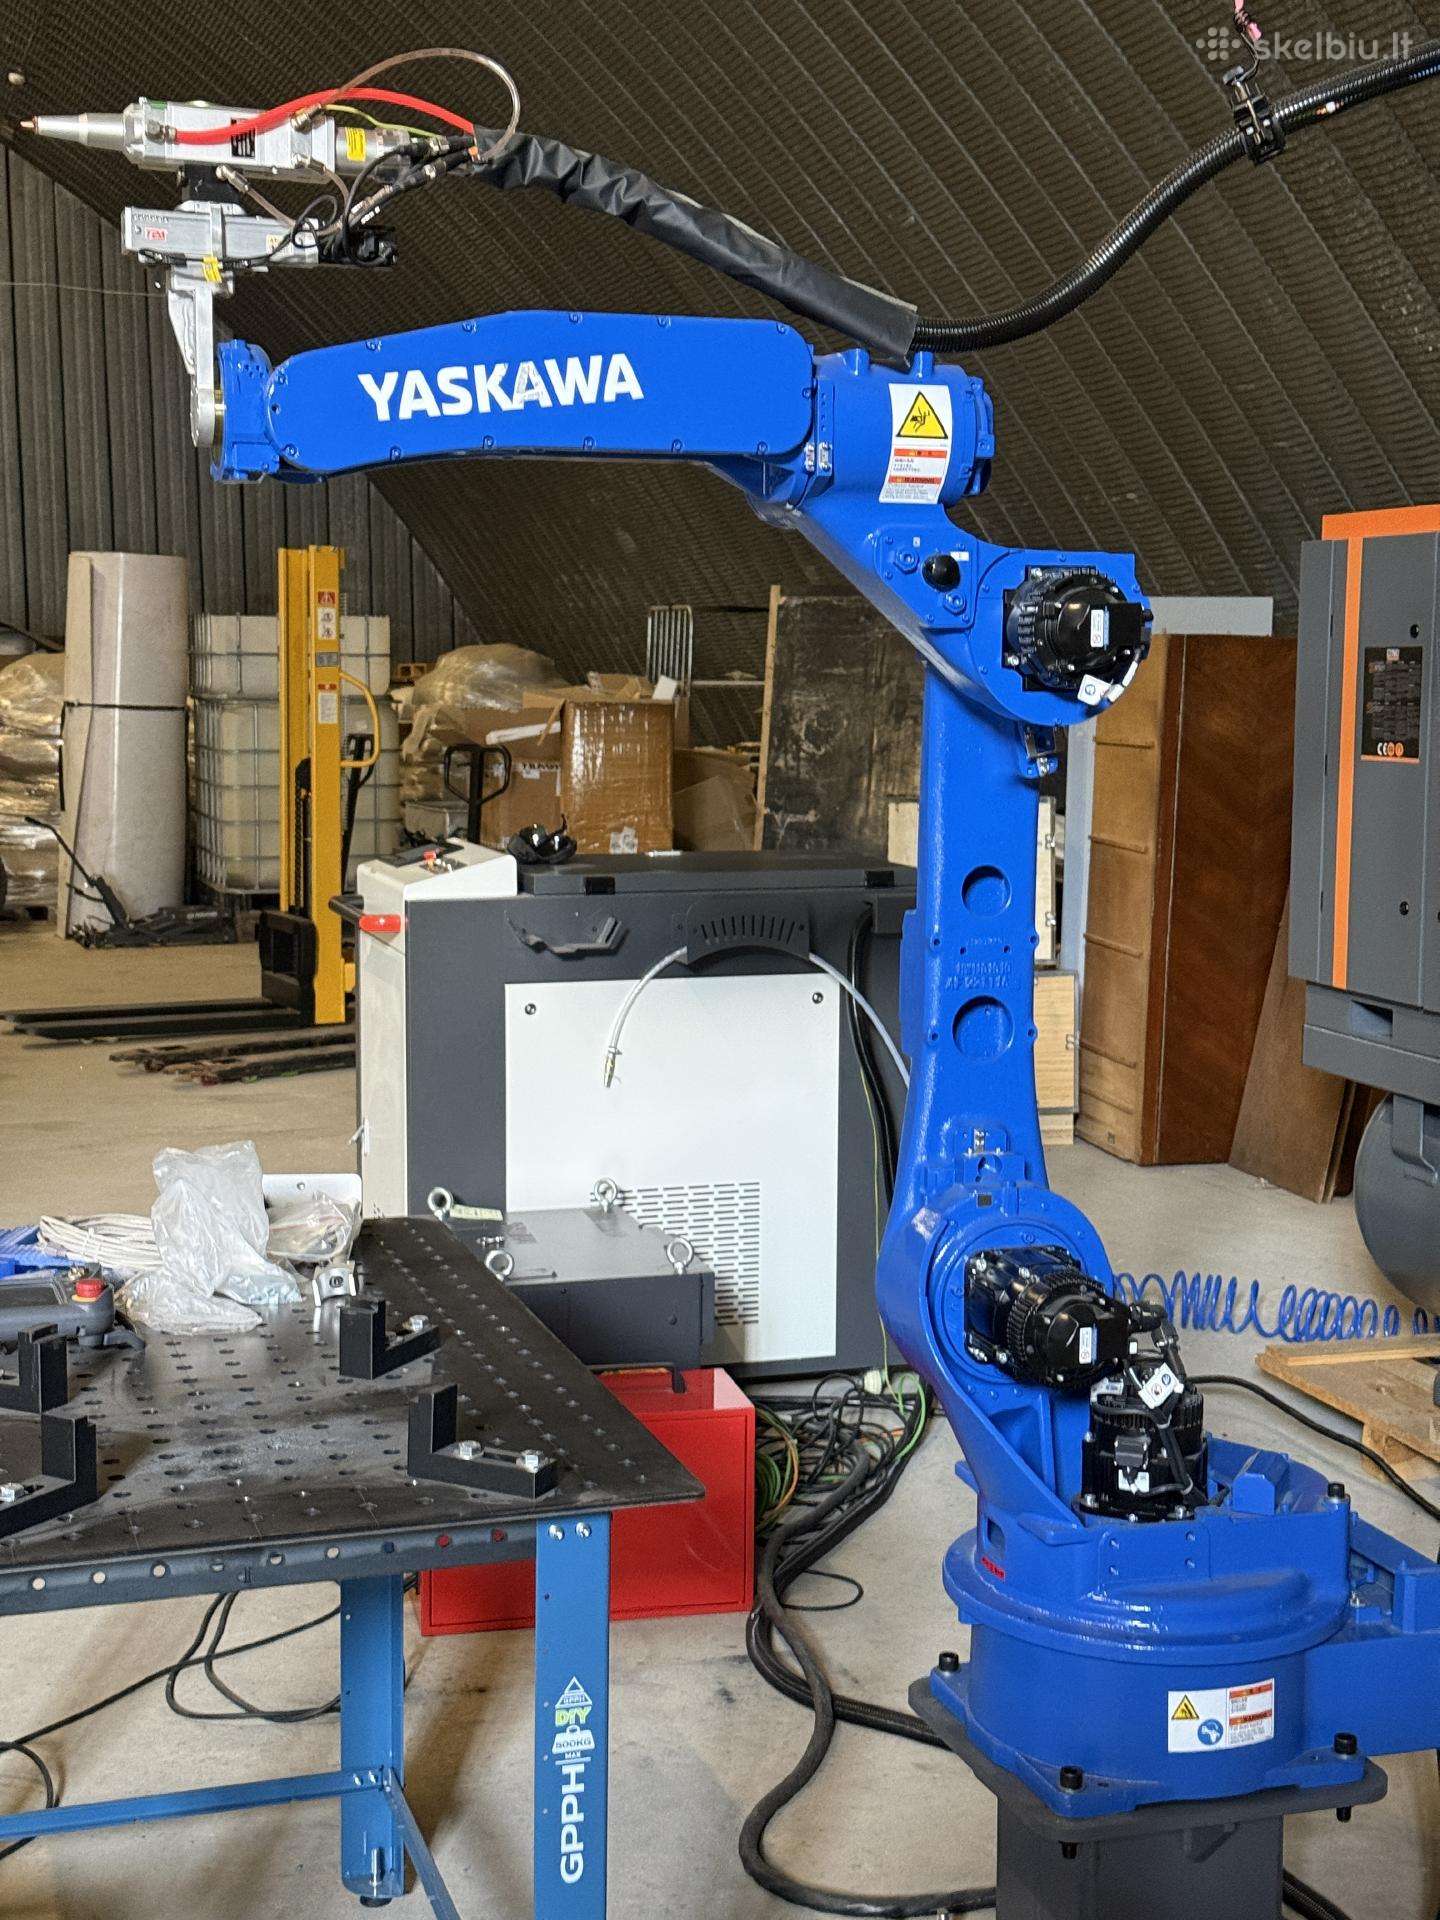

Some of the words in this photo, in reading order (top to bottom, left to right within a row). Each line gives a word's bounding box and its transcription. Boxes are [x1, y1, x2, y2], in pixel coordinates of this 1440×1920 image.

[357, 353, 644, 421] YASKAWA
[555, 1706, 592, 1727] DIY
[560, 1763, 585, 1884] GPPH
